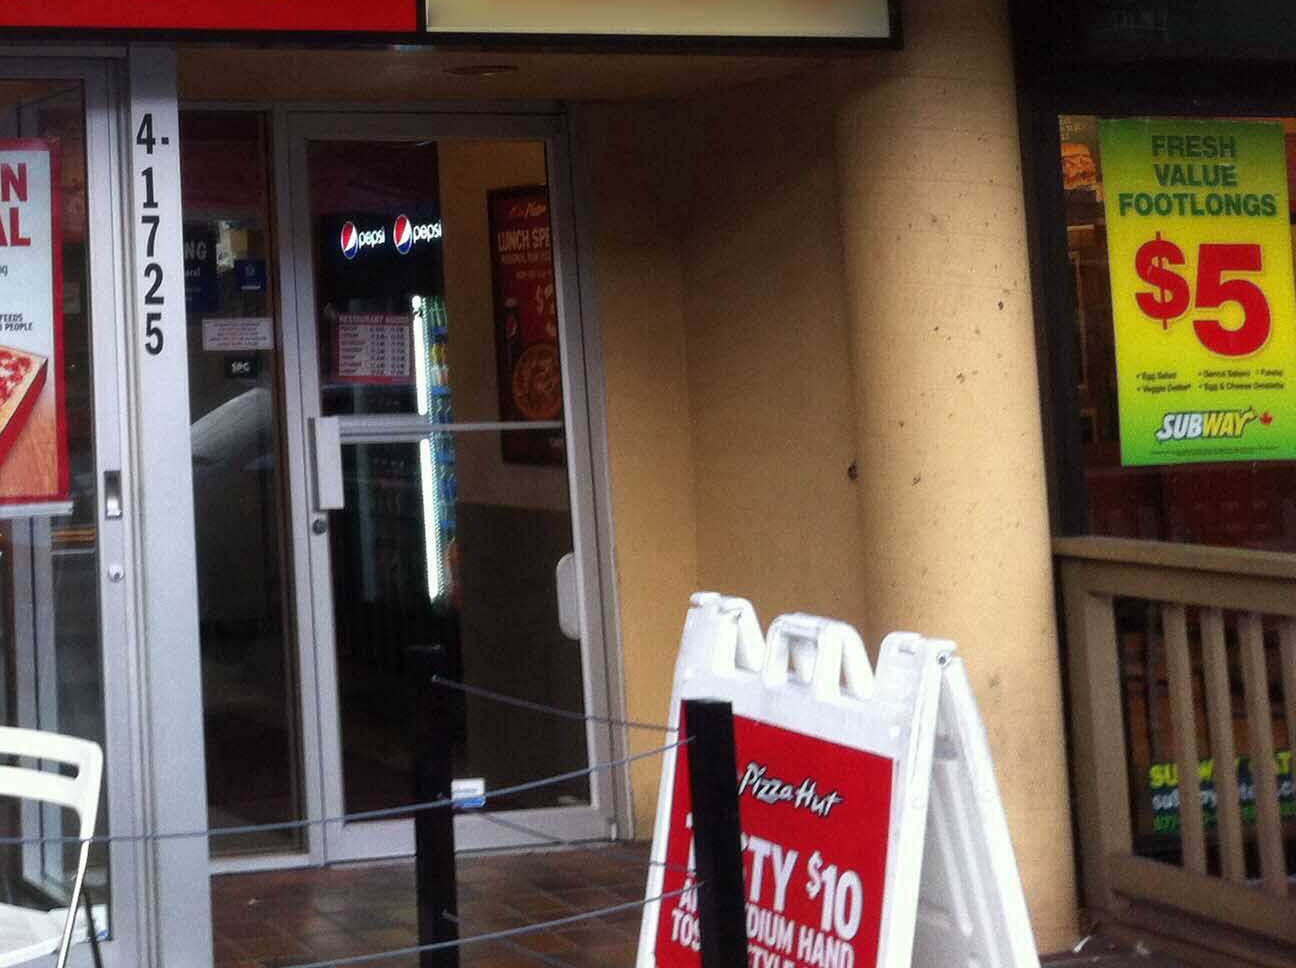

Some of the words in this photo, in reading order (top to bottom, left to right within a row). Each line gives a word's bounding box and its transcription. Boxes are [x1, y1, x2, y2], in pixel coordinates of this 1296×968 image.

[1152, 135, 1237, 158] FRESH
[1154, 164, 1238, 187] VALUE
[1119, 193, 1277, 217] FOOTLONGS
[359, 227, 385, 249] pepsi
[413, 219, 442, 244] pepsi
[1135, 231, 1272, 358] $5
[4, 322, 32, 331] PEOPLE
[1156, 407, 1257, 443] SUBWAY
[738, 762, 794, 804] Pizza
[795, 778, 844, 816] Hut
[806, 850, 864, 941] $10
[798, 925, 855, 968] HAND
